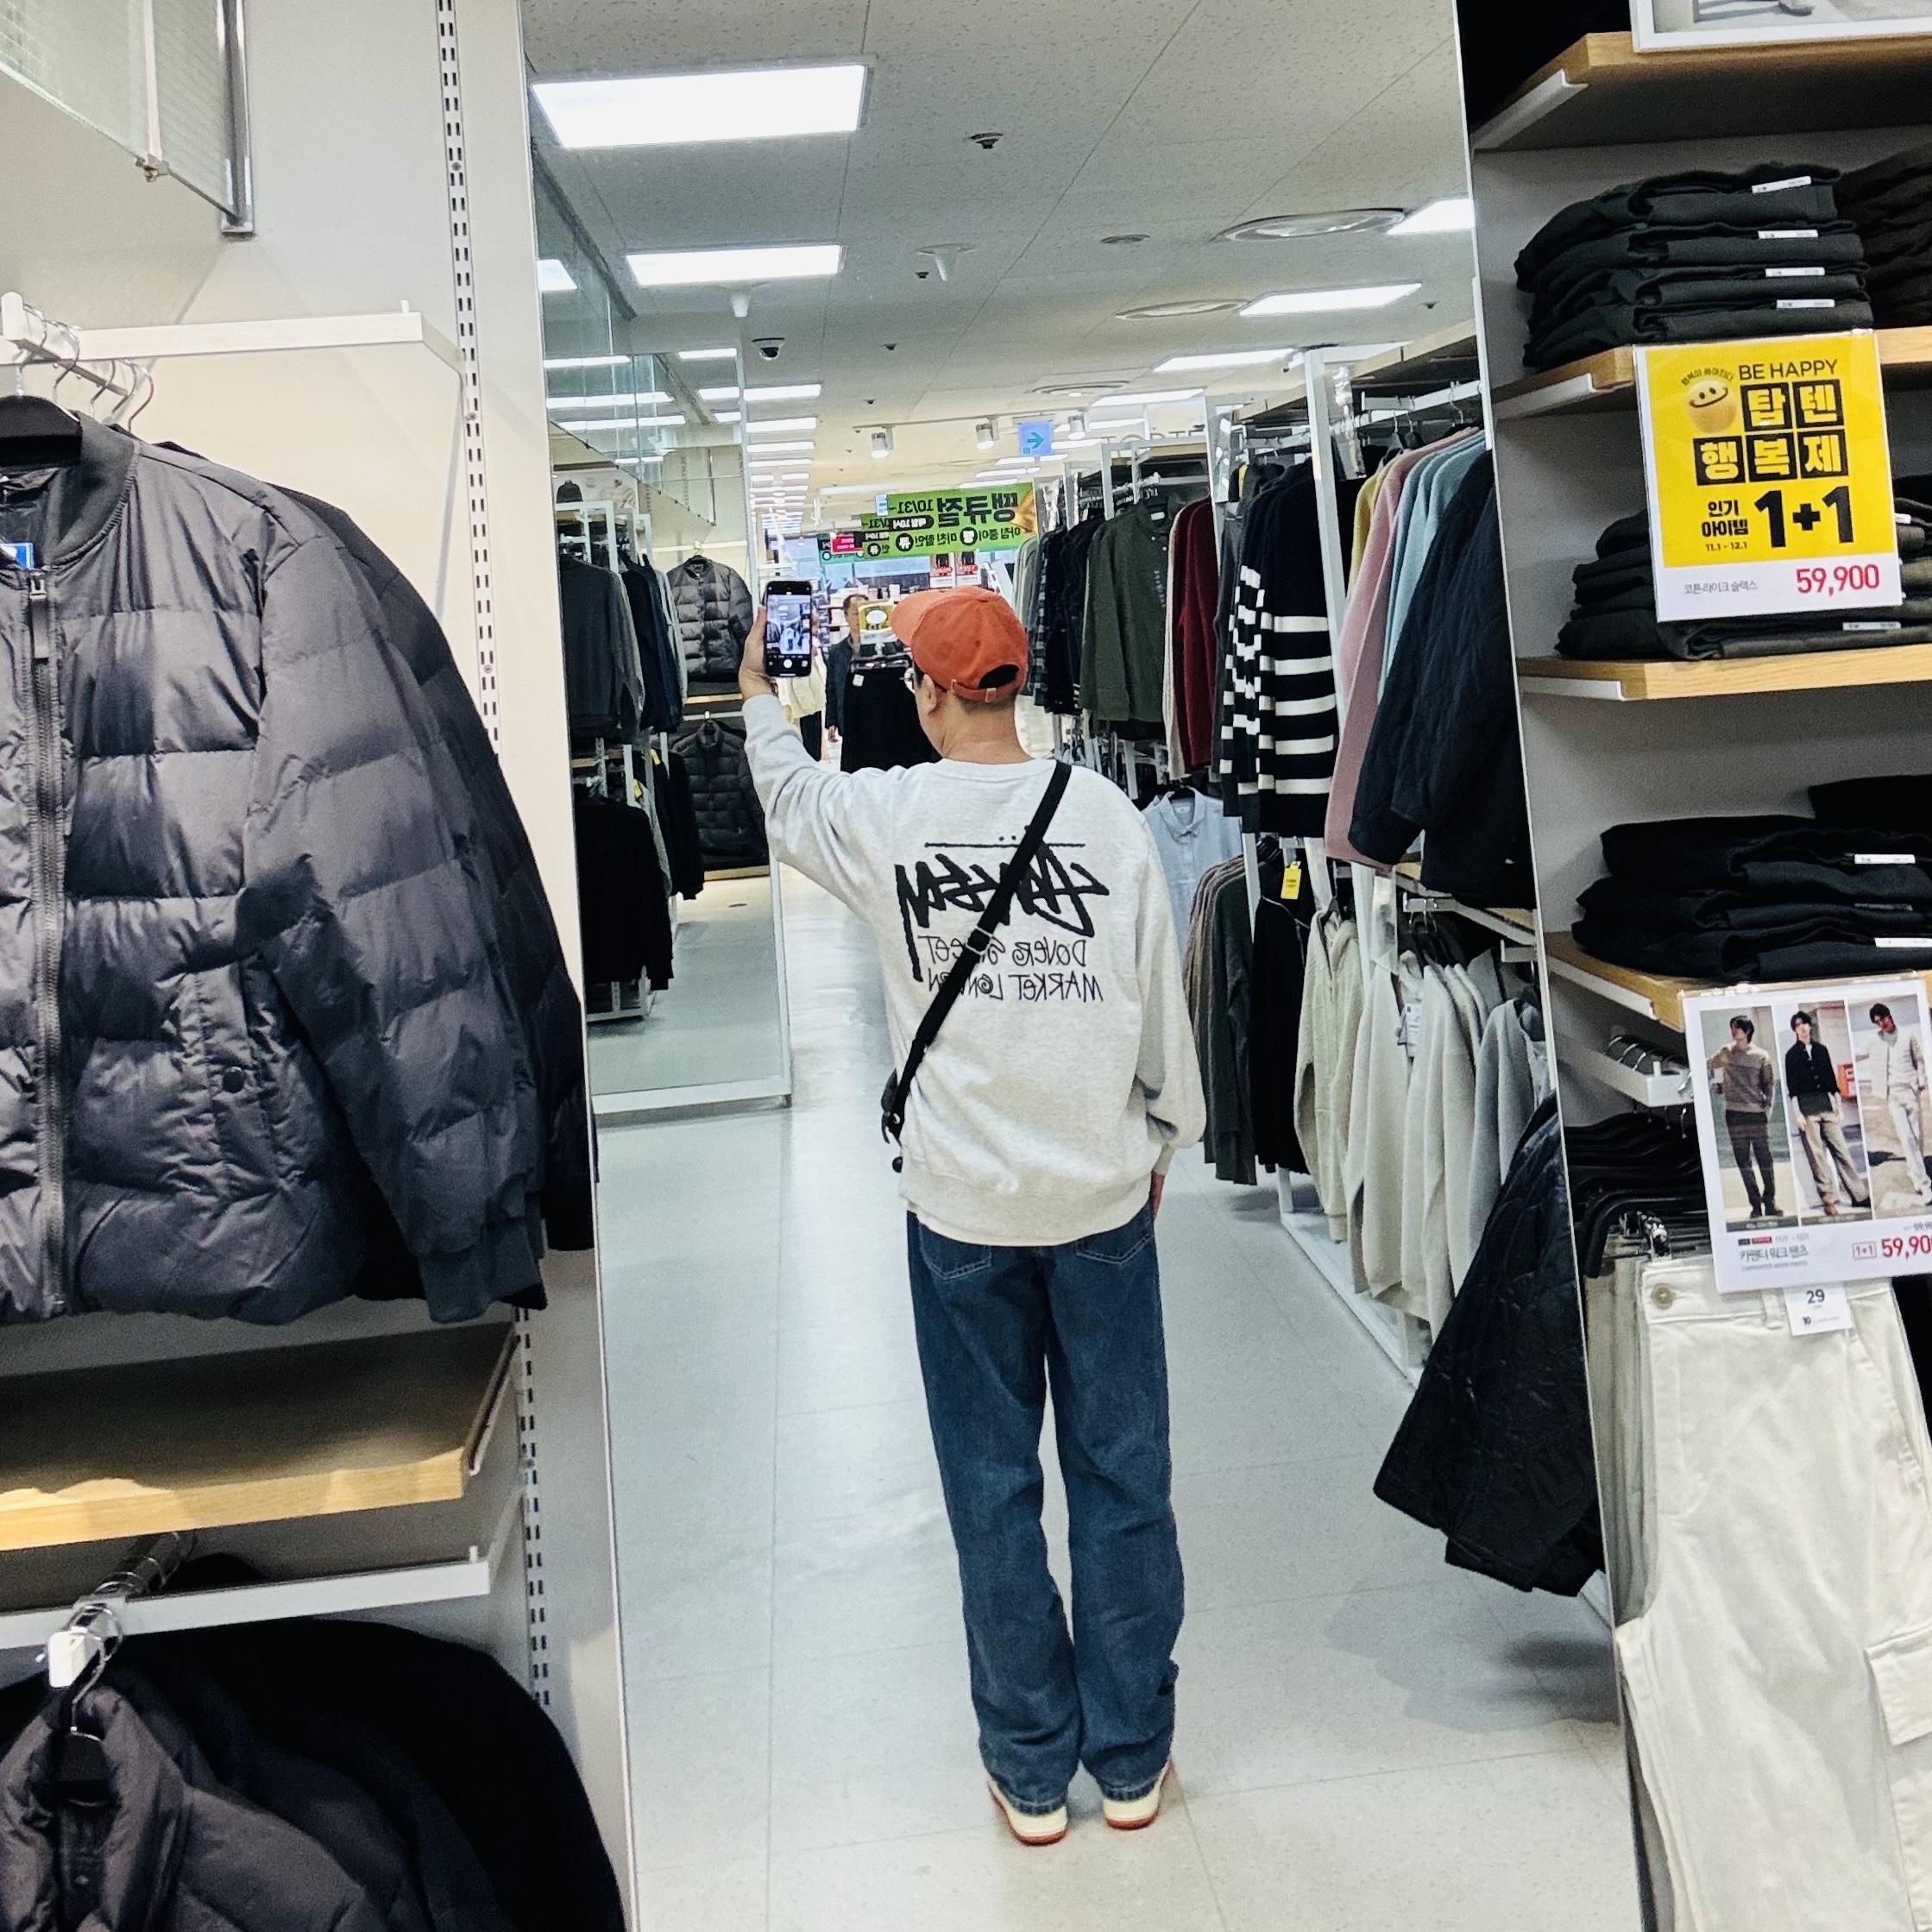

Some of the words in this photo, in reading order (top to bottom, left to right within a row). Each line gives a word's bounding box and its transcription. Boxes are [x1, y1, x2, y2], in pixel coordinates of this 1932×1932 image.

[1739, 364, 1765, 381] BE
[1771, 359, 1838, 378] HAPPY
[1708, 499, 1740, 518] 인기
[1753, 486, 1854, 548] 1+1
[1702, 519, 1749, 538] 아이템
[1796, 563, 1880, 597] 59,900
[1855, 1244, 1873, 1257] 1+1
[1881, 1235, 1932, 1260] 59,90
[1805, 1288, 1826, 1304] 29
